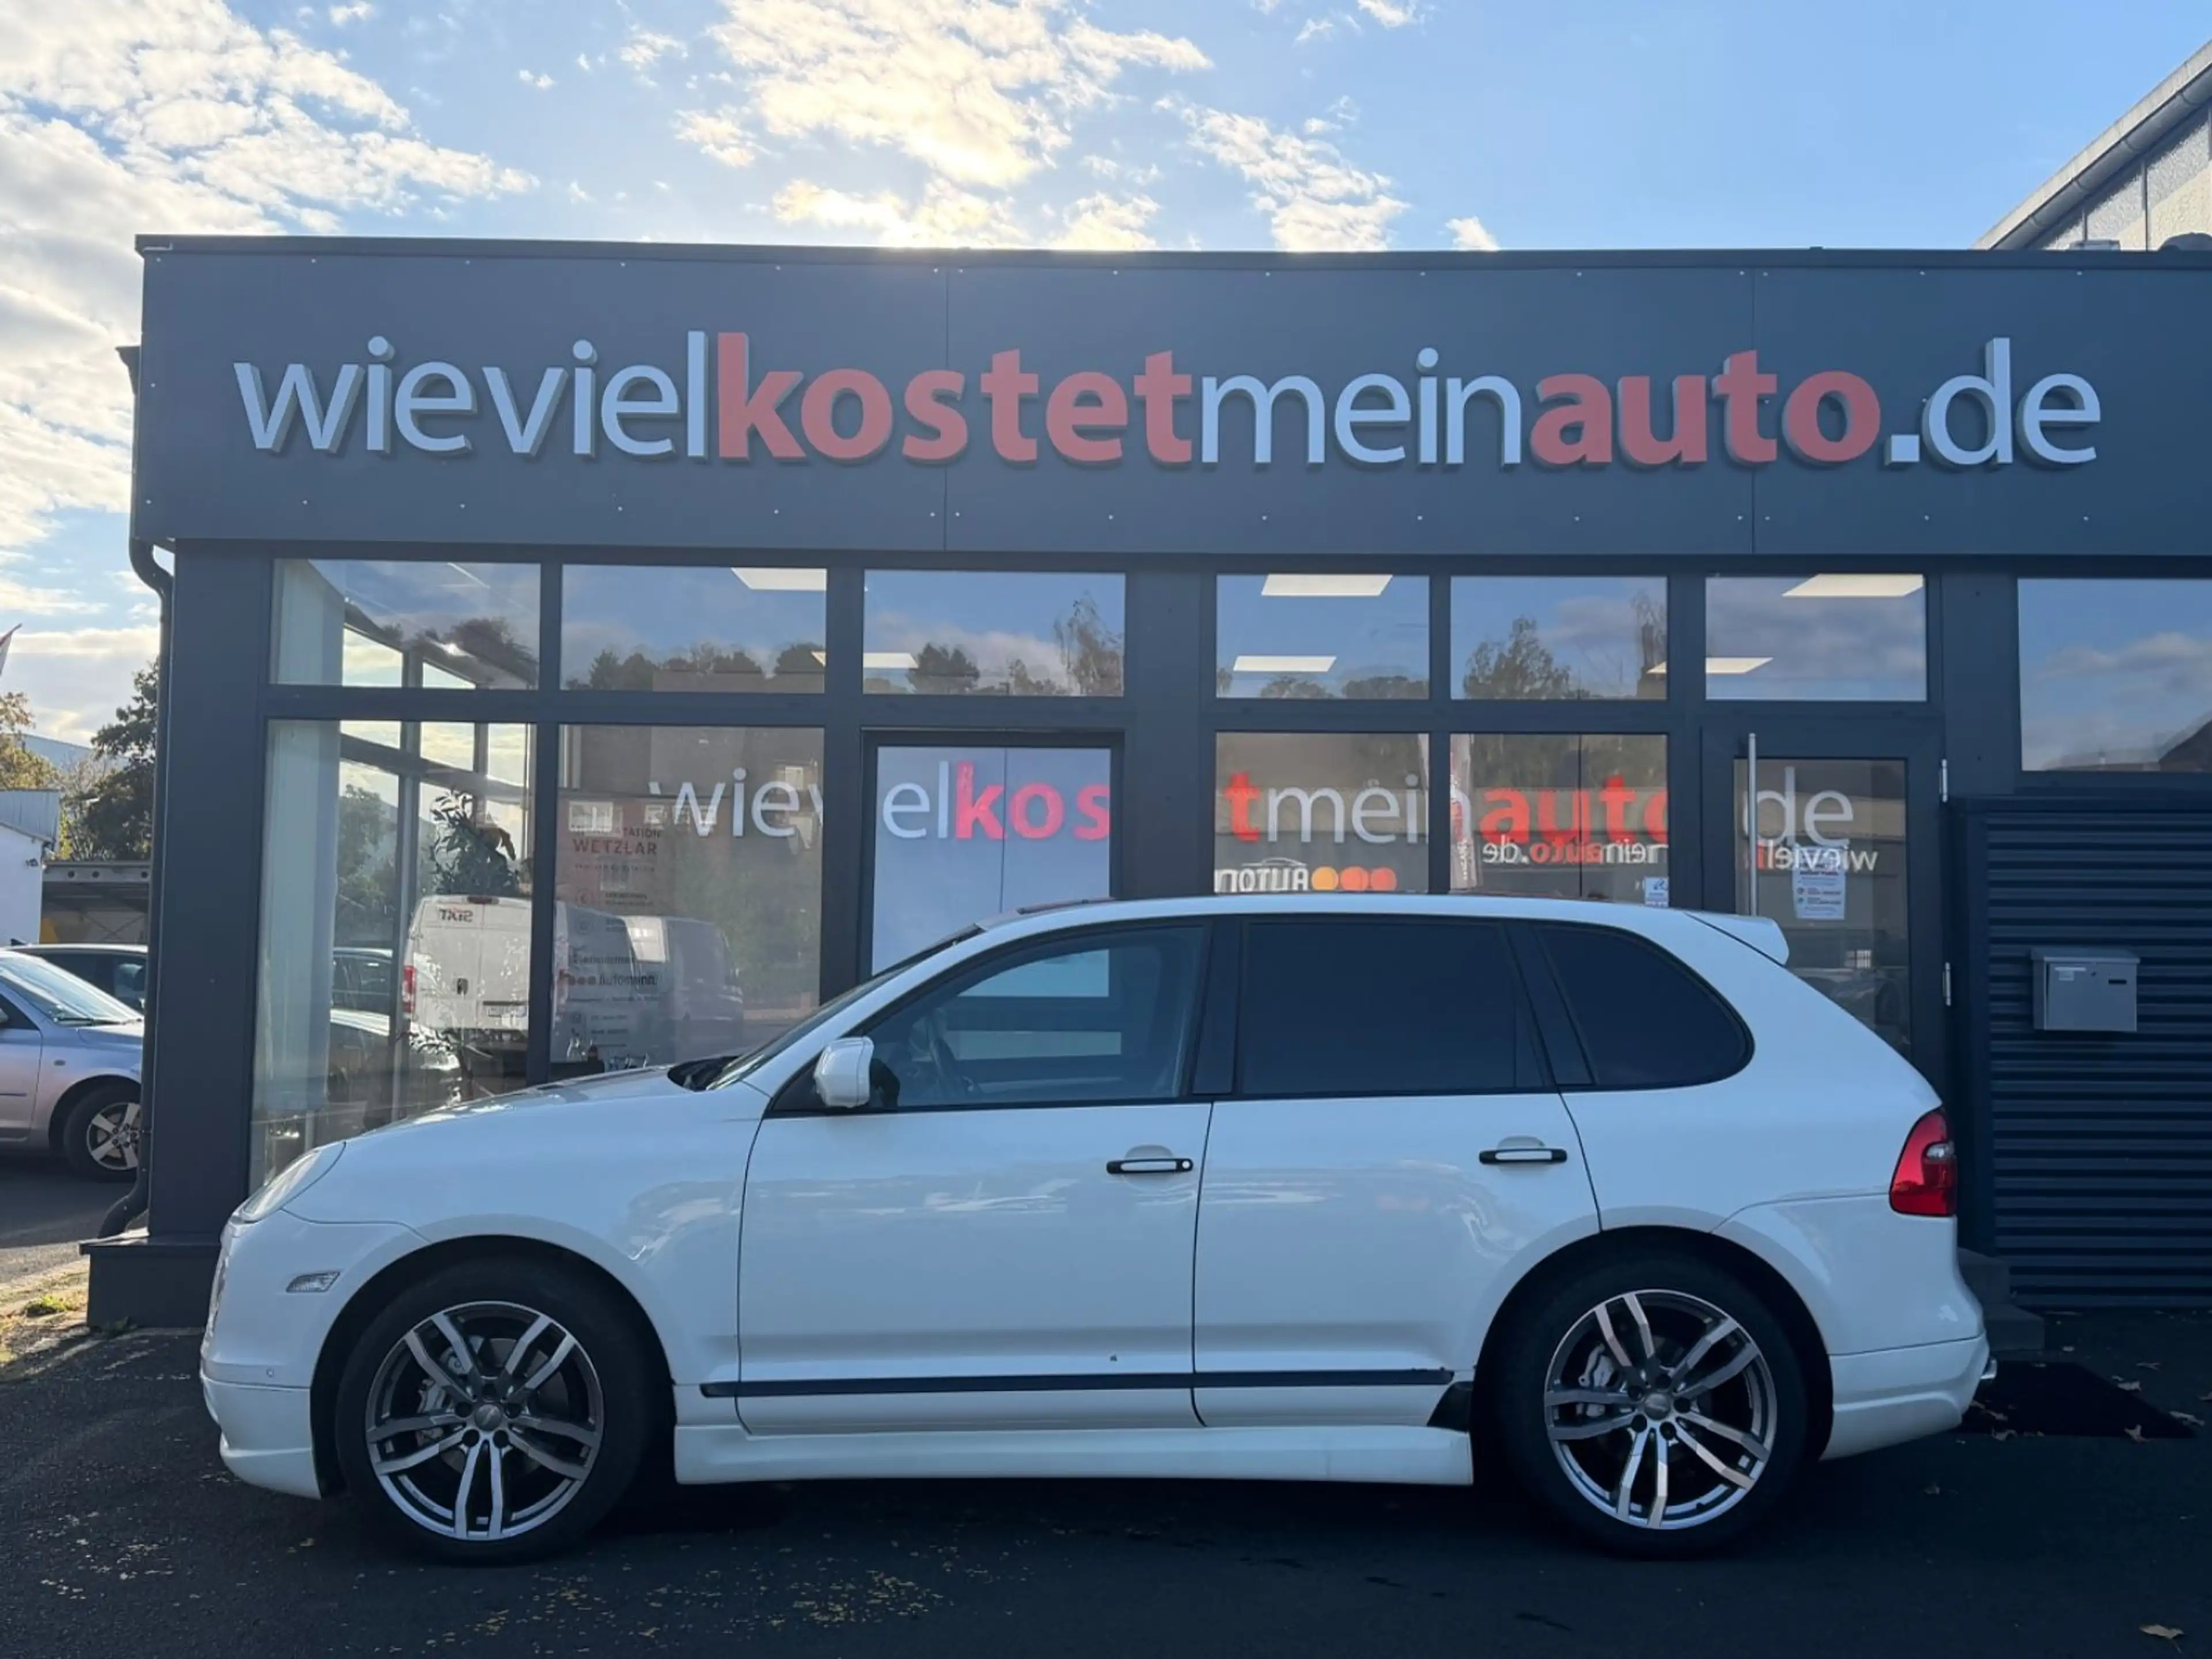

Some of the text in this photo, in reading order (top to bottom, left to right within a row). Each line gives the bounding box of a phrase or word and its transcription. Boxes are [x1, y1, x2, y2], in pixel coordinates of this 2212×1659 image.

[233, 329, 2104, 470] wievielkostetmeinauto.de
[649, 767, 824, 839] wie
[572, 838, 657, 855] WETZLAR
